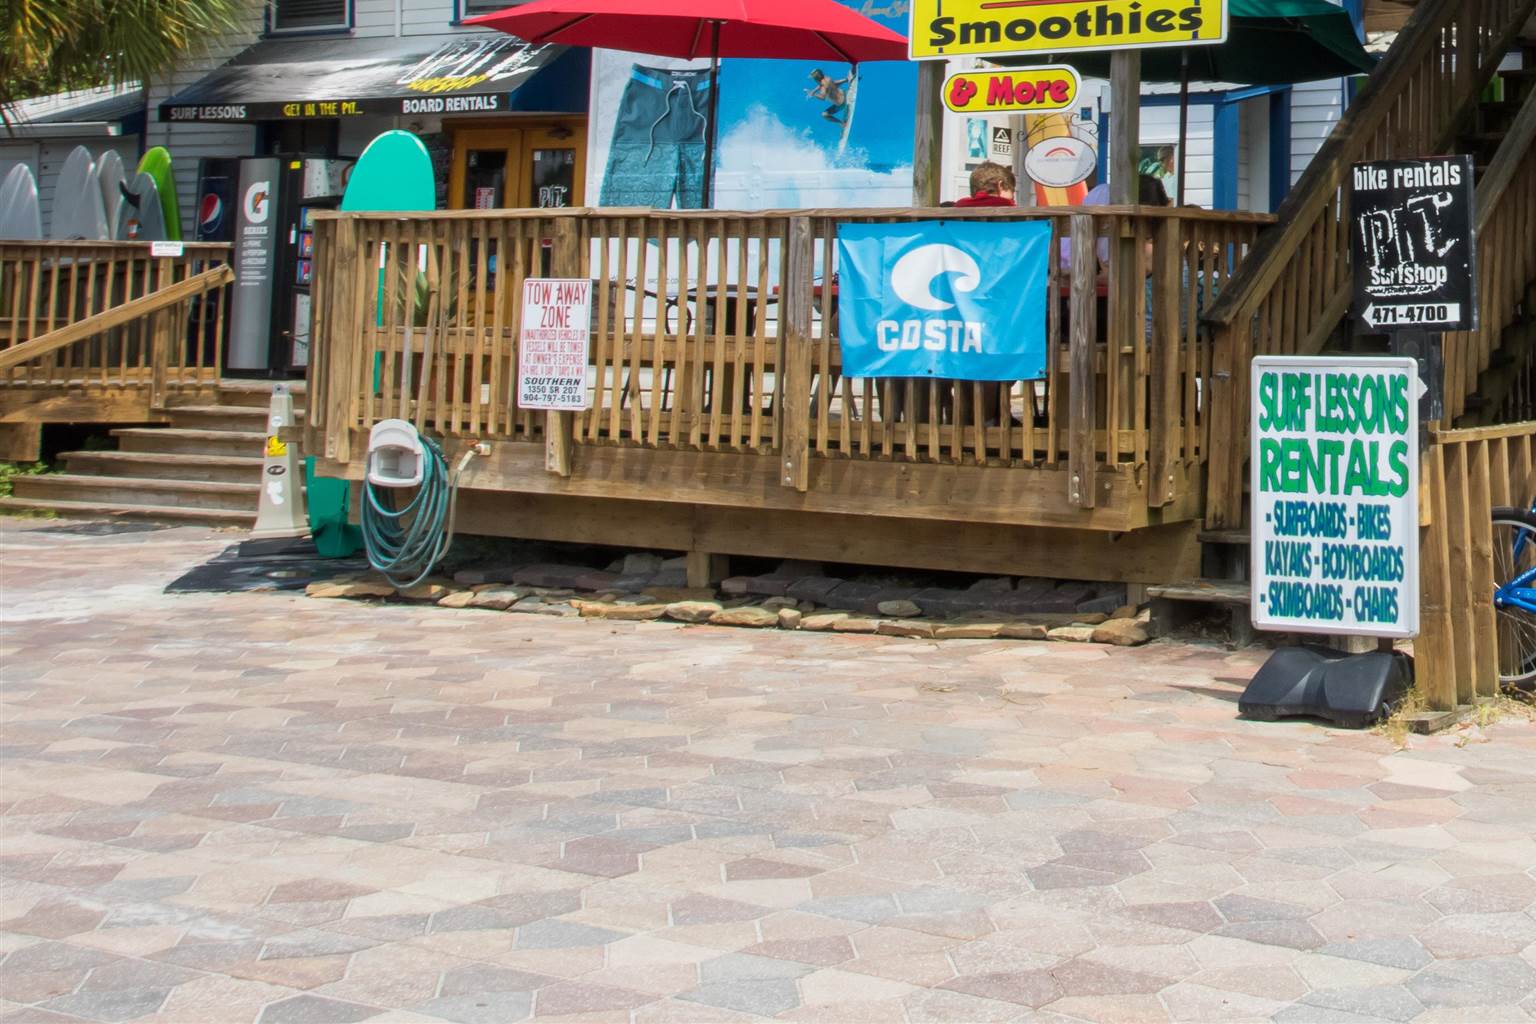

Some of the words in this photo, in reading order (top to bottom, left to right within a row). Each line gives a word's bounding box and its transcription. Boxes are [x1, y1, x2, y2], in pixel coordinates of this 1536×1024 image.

[930, 1, 1203, 47] Smoothies
[402, 98, 444, 114] BOARD
[446, 95, 498, 112] RENTALS
[948, 77, 977, 107] &
[986, 76, 1071, 107] More
[170, 107, 197, 120] SURF
[199, 105, 247, 119] LESSONS
[305, 103, 316, 116] IN
[320, 102, 338, 116] THE
[993, 143, 1011, 153] REEF
[1354, 166, 1388, 191] bike
[1393, 161, 1461, 188] rentals
[527, 283, 553, 305] TOW
[556, 283, 587, 305] AWAY
[541, 306, 570, 328] ZONE
[1372, 305, 1448, 323] 471-4700
[877, 319, 983, 353] COSTA
[524, 377, 581, 386] SOUTHERN
[550, 386, 560, 394] SR
[1259, 372, 1311, 432] SURF
[1315, 373, 1409, 435] LESSONS
[1260, 438, 1409, 498] RENTALS
[1274, 500, 1347, 539] SURFBOARDS
[1357, 503, 1391, 540] BIKES
[1265, 541, 1312, 578] KAYAKS
[1322, 545, 1404, 583] BODYBOARDS
[1268, 581, 1344, 620] SKIMBOARDS
[1354, 586, 1398, 624] CHAIRS
